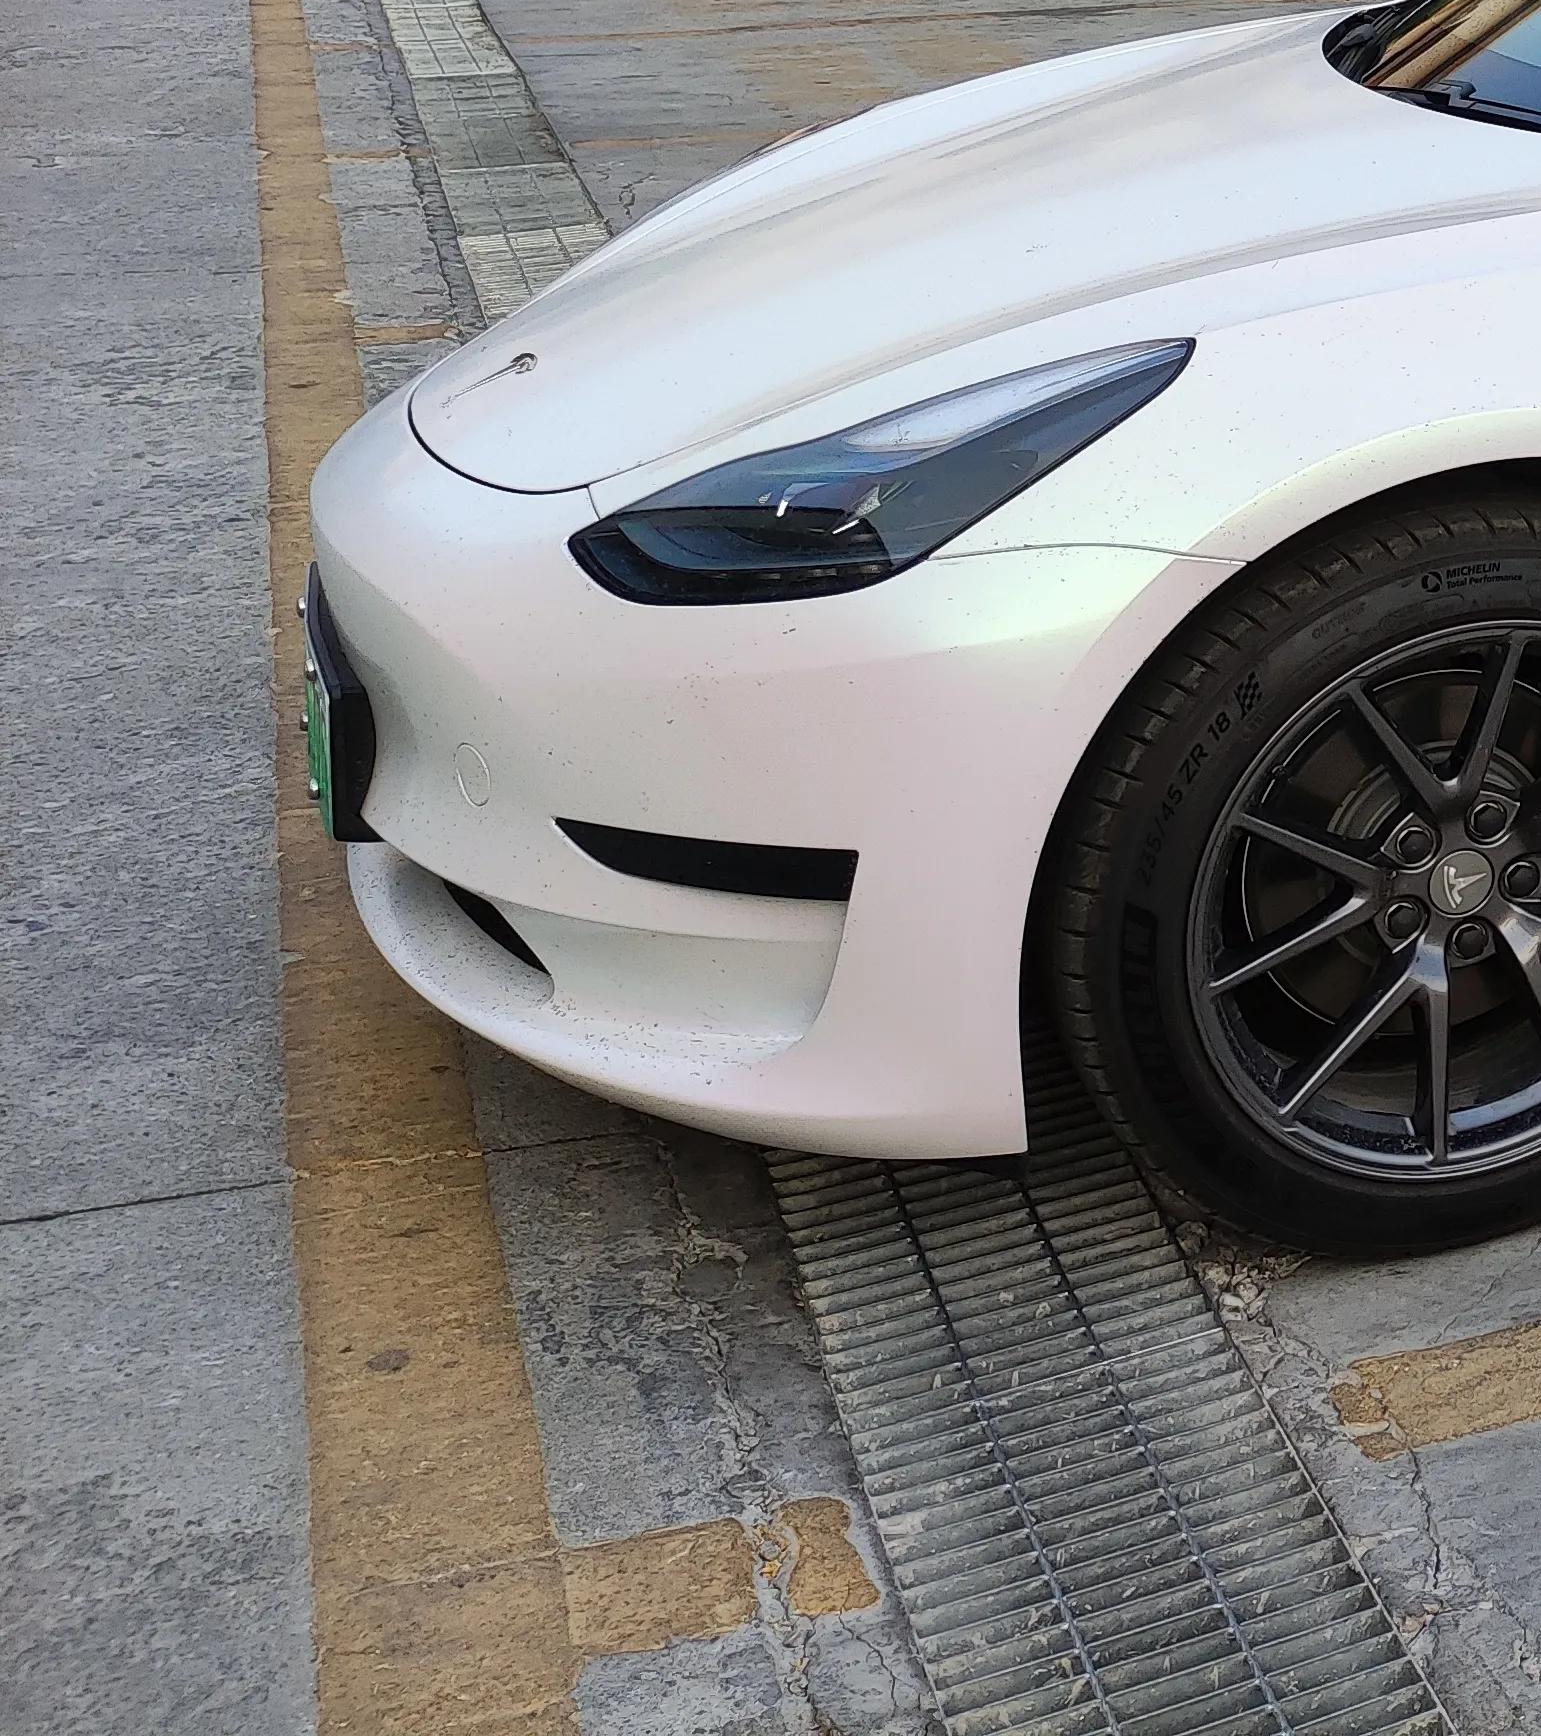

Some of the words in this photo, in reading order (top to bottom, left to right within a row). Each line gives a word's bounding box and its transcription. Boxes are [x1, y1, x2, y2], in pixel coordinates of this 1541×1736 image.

[1446, 562, 1501, 579] MICHELIN
[1447, 578, 1467, 590] Total
[1468, 574, 1522, 586] Performance
[1137, 783, 1183, 886] 235/45
[1179, 742, 1209, 785] ZR
[1206, 710, 1232, 742] 18
